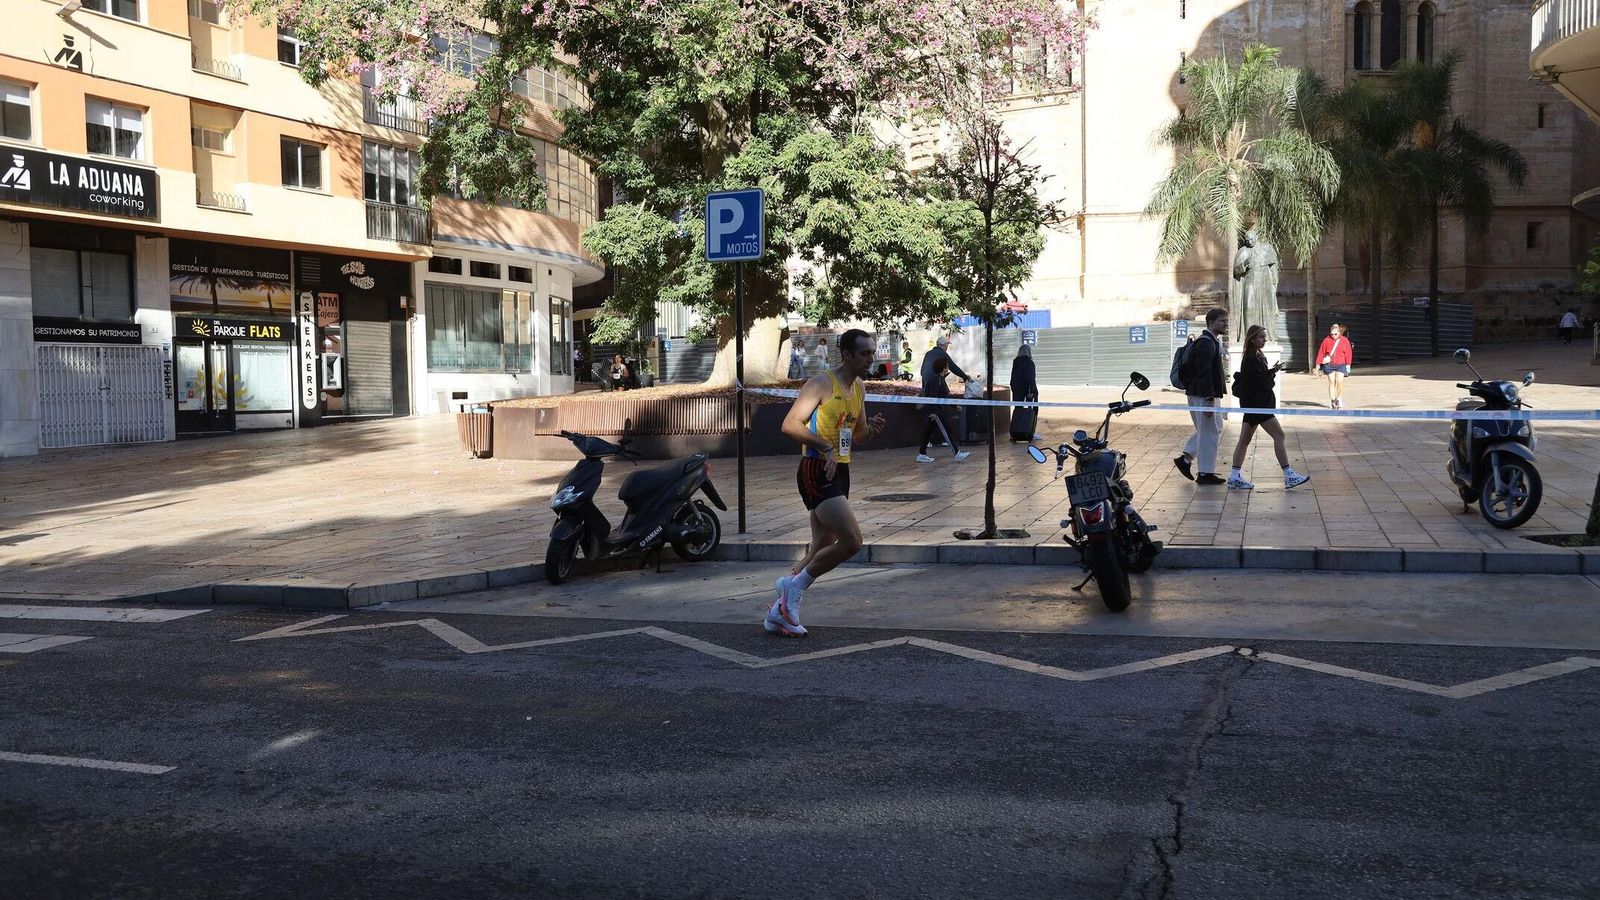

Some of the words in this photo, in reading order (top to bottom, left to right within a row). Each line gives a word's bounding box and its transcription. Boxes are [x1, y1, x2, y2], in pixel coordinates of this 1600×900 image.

[49, 161, 70, 186] LA
[78, 166, 144, 196] ADUANA
[89, 193, 144, 210] coworking
[710, 198, 744, 253] P
[727, 242, 758, 254] MOTOS
[212, 267, 254, 277] APARTAMENTOS
[318, 296, 338, 307] ATM
[34, 327, 86, 336] GESTIONAMOS
[88, 329, 98, 337] SU
[99, 329, 140, 338] PATRIMONIO
[213, 326, 246, 337] PARQUE
[249, 325, 281, 338] FLATS
[303, 303, 313, 396] SNEAKERS
[1082, 486, 1103, 500] LCD
[645, 525, 663, 542] YAMAHA
